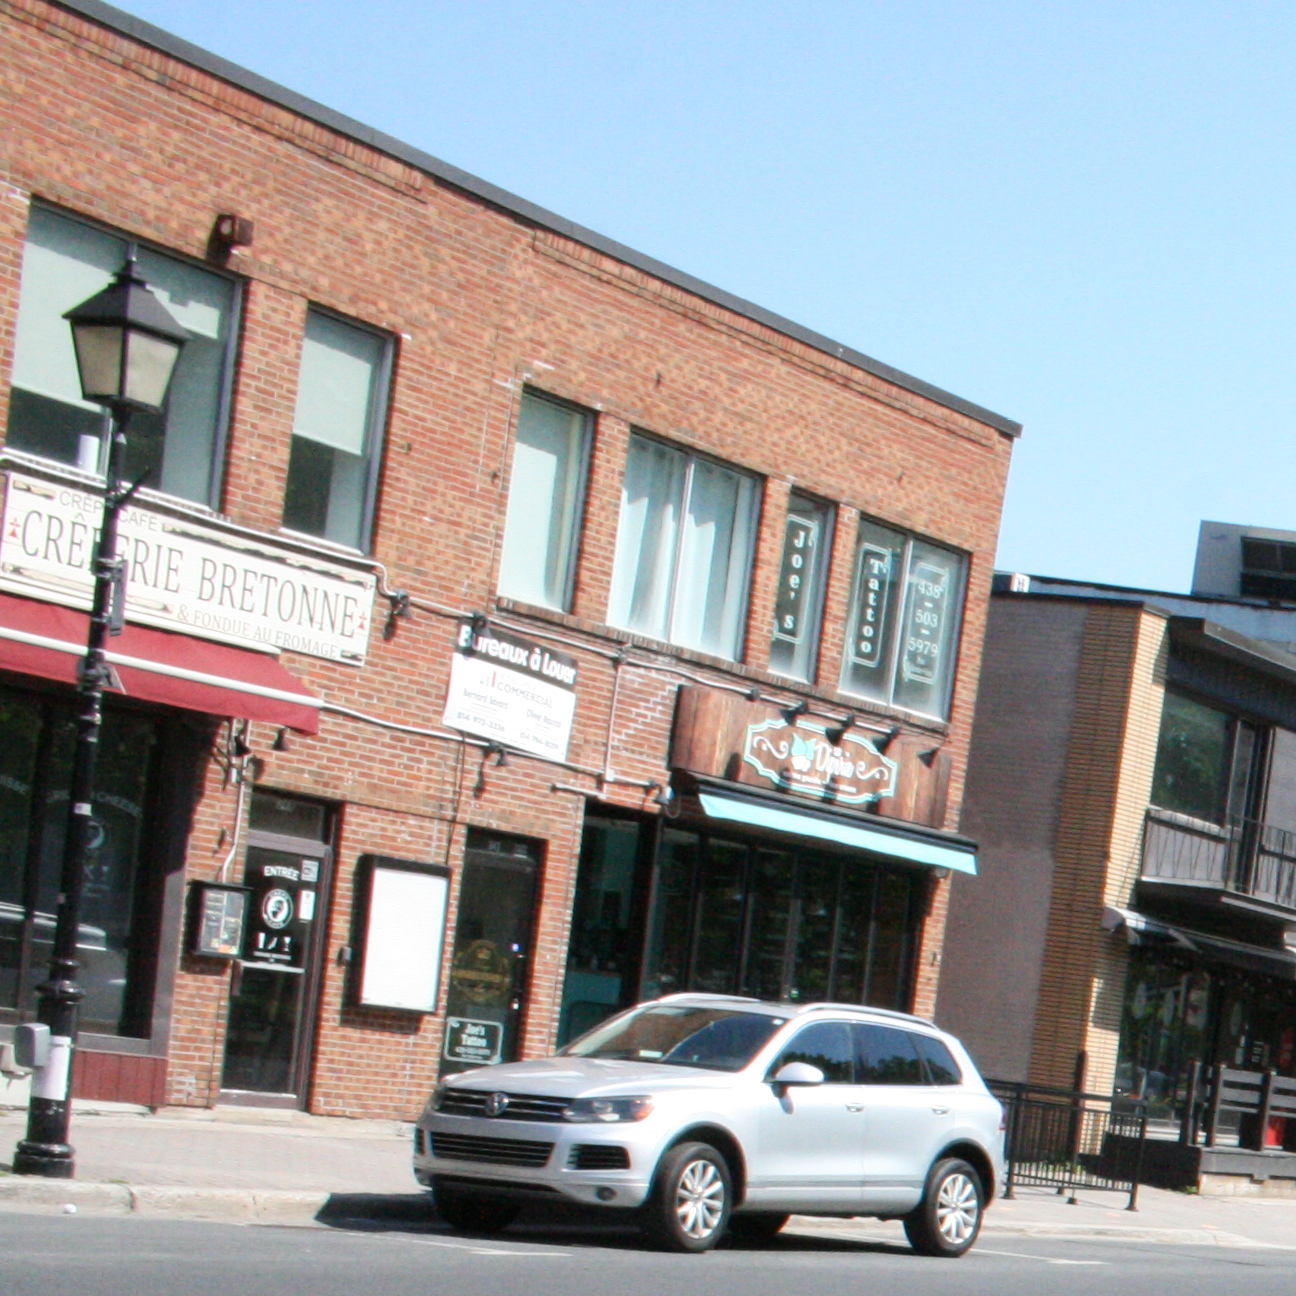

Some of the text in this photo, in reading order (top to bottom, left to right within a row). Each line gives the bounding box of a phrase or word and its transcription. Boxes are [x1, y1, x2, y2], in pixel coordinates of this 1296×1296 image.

[198, 556, 358, 639] BRETONNE
[860, 558, 884, 654] Tattoo
[914, 609, 939, 628] 503
[177, 602, 338, 660] & FONDUE AU FROMAGE
[458, 624, 530, 667] Bureaux
[529, 647, 542, 671] à
[541, 652, 577, 685] Louer
[907, 636, 939, 658] 5979
[263, 864, 300, 881] ENTRÉE
